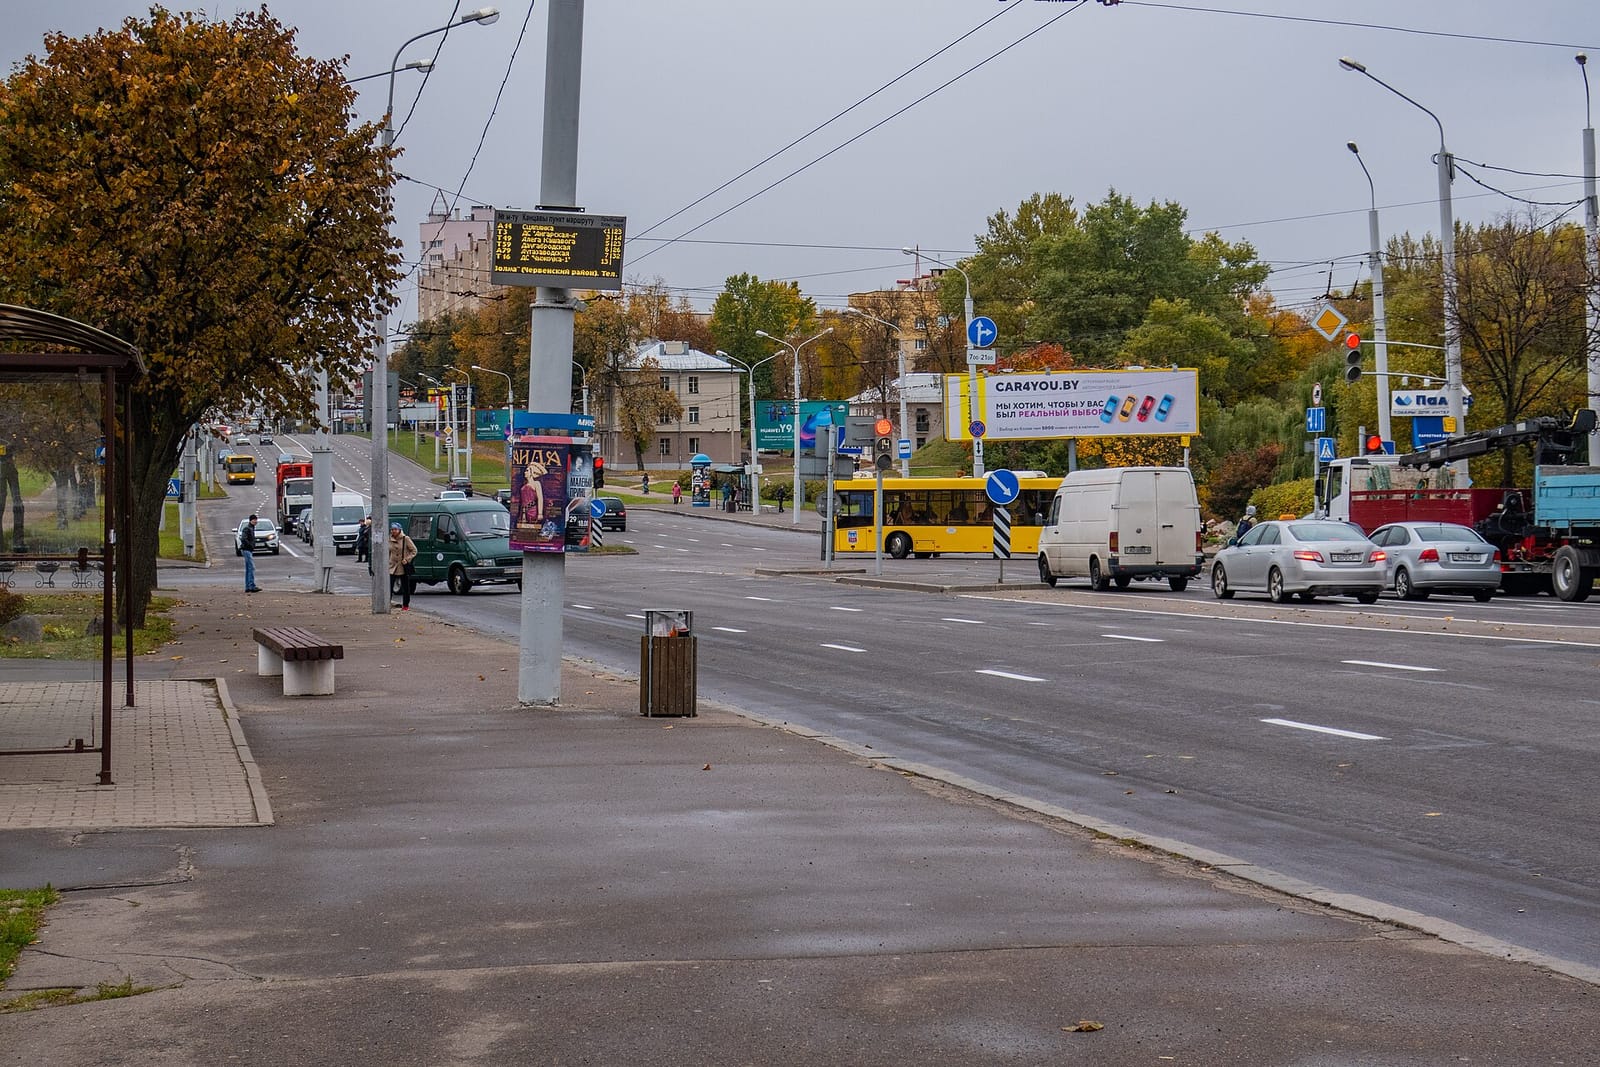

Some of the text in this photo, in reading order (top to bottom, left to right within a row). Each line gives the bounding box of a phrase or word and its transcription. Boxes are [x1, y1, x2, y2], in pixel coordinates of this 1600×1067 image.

[995, 380, 1080, 393] CAR4YOU.BY
[1013, 401, 1046, 410] ХОТИМ,
[1048, 400, 1078, 408] ЧТОБЫ
[996, 411, 1016, 419] БЫЛ
[1018, 408, 1070, 418] РЕАЛЬНЫЙ
